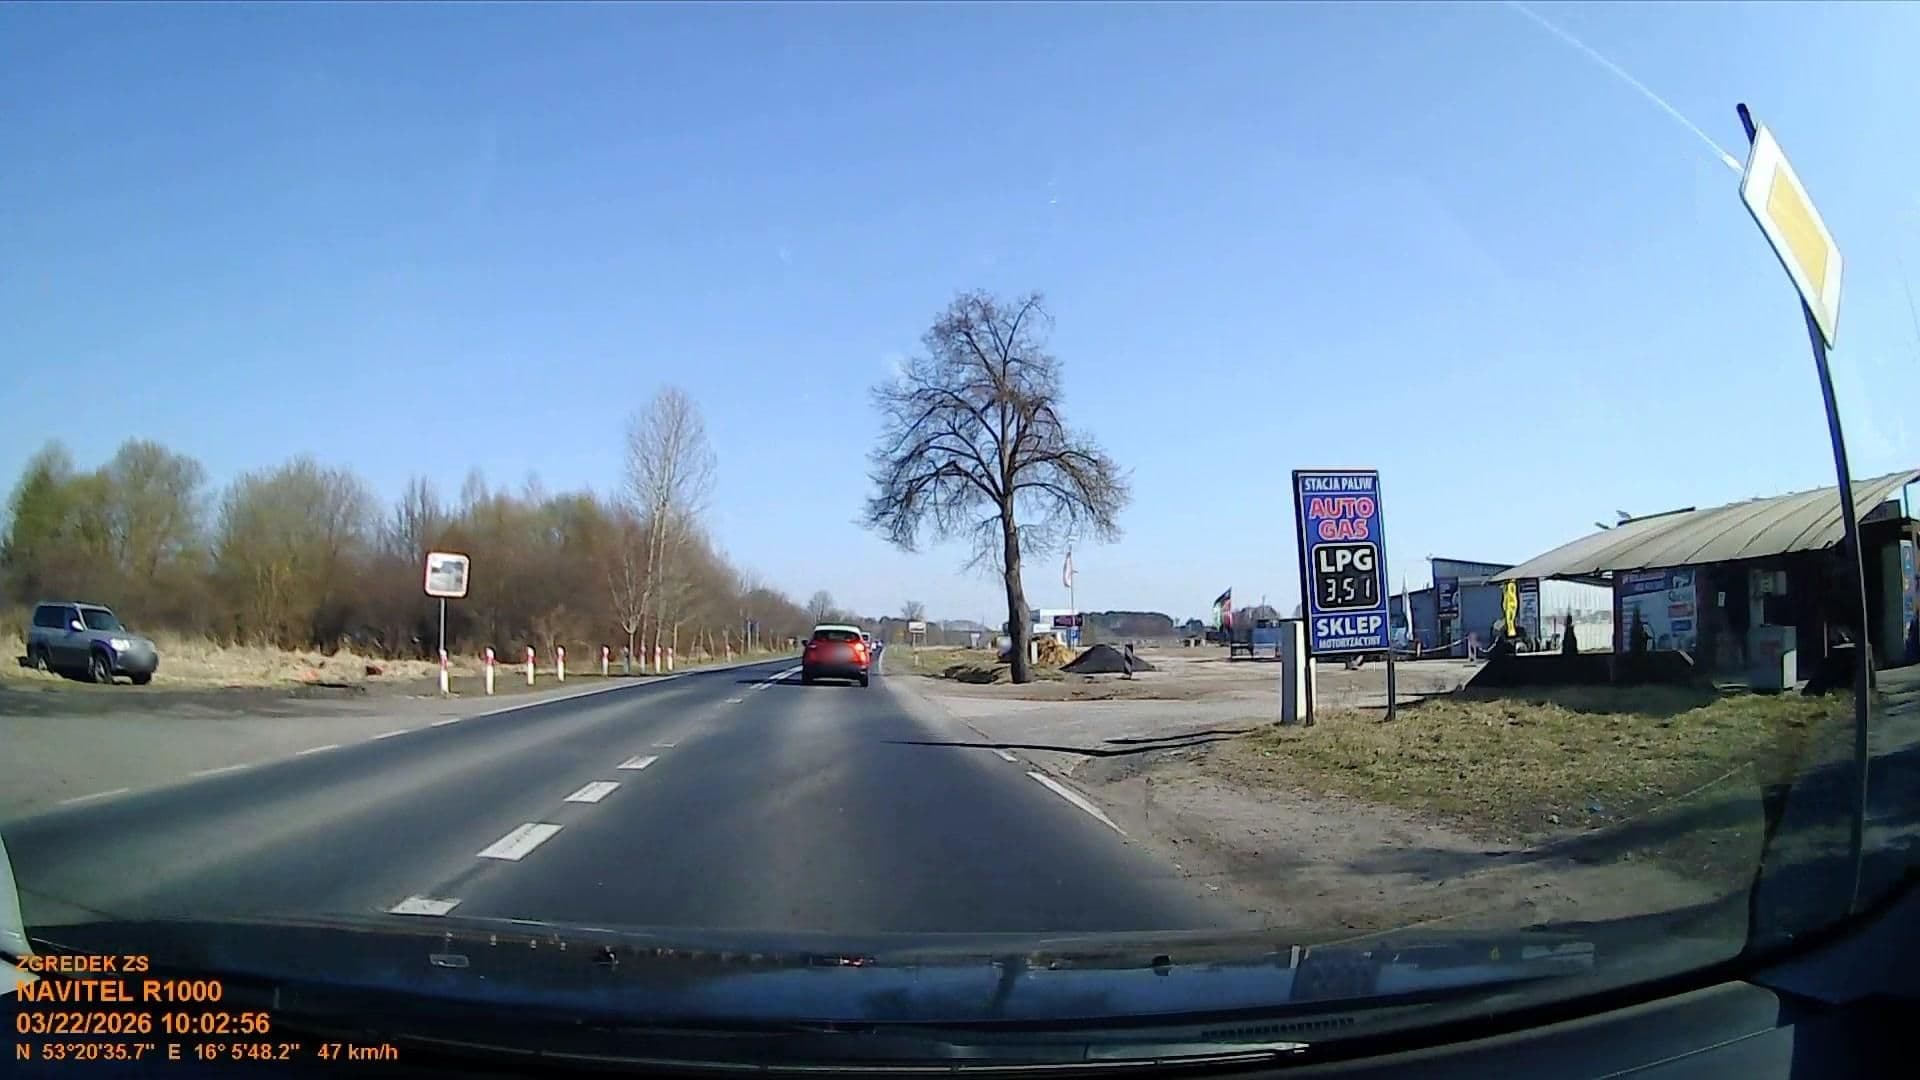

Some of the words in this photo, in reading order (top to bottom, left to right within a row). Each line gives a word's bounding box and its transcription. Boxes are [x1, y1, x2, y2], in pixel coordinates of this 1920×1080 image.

[1304, 477, 1340, 491] STACJA
[1341, 476, 1373, 490] PALIW
[1309, 496, 1375, 520] AUTO
[1318, 518, 1370, 540] GAS
[1319, 548, 1373, 573] LPG
[1316, 616, 1383, 637] SKLEP
[1318, 636, 1382, 649] MOTORYZACYJNY
